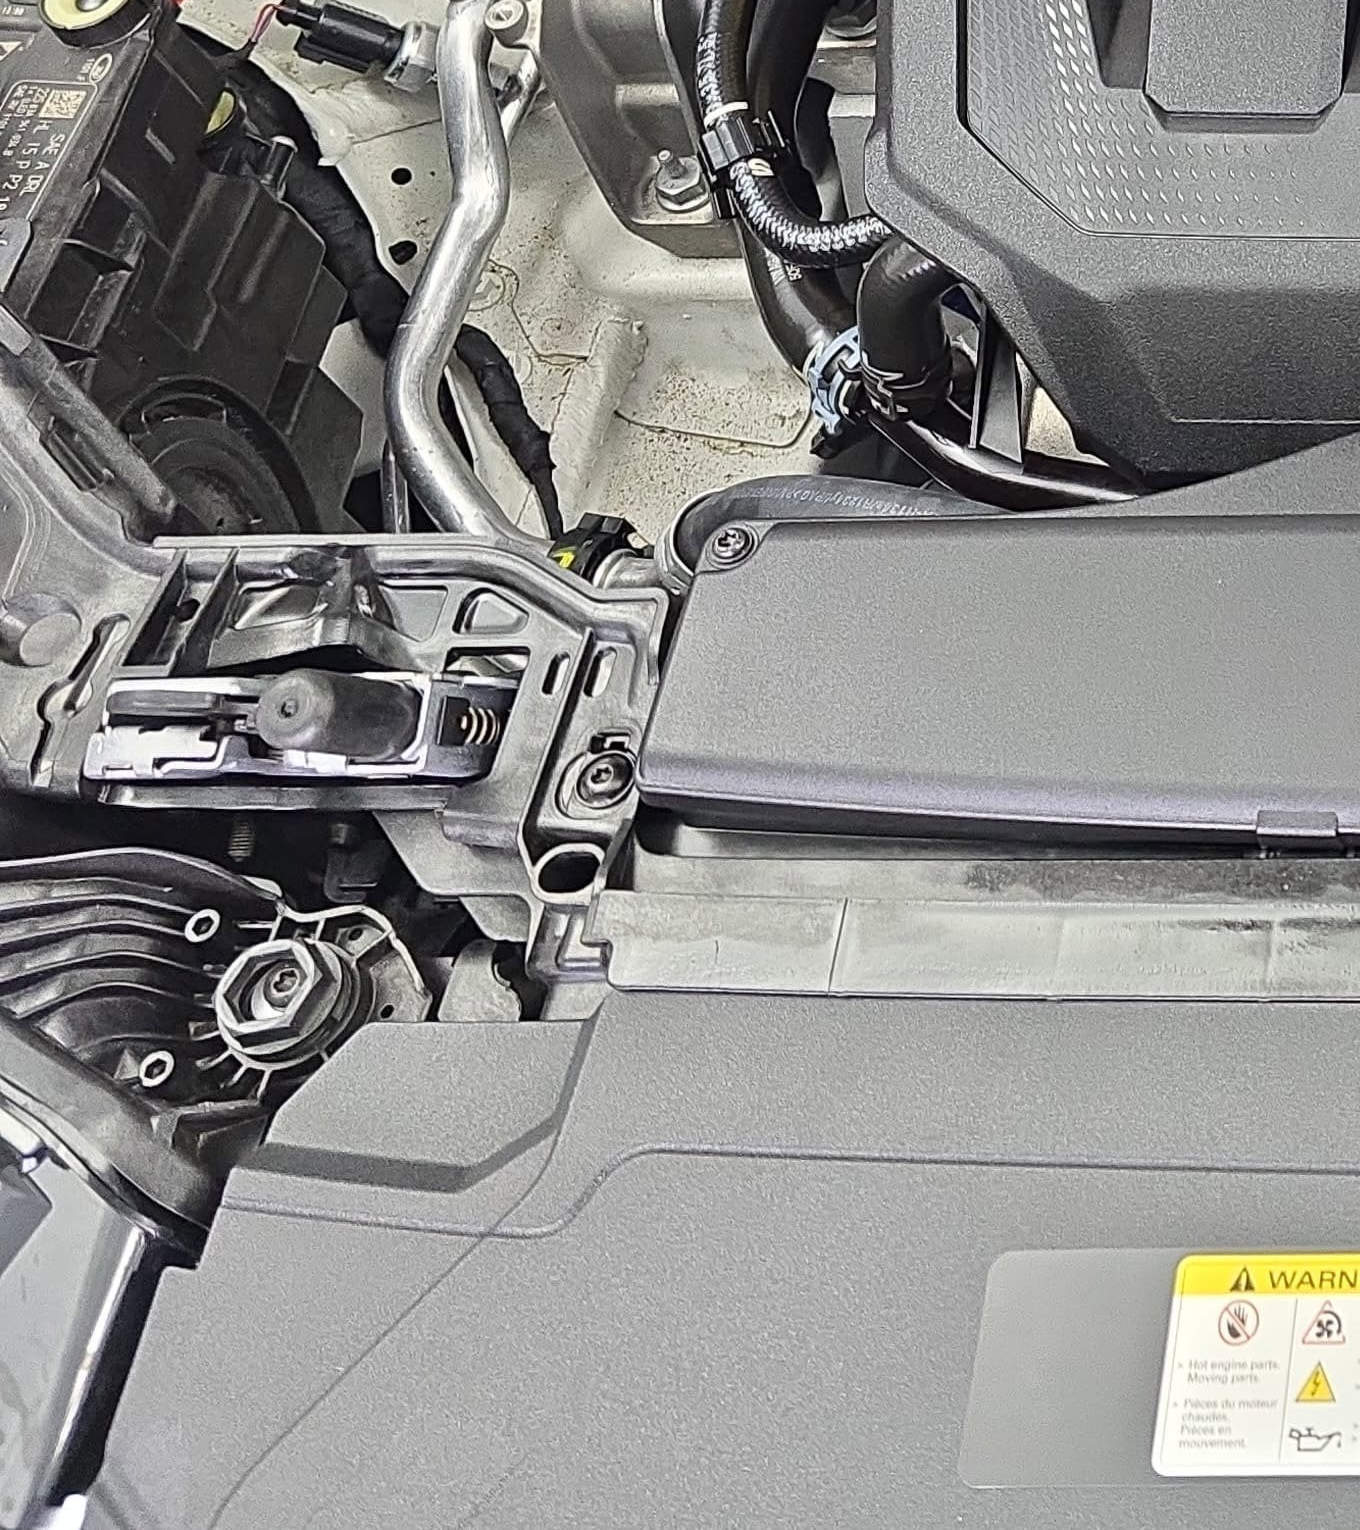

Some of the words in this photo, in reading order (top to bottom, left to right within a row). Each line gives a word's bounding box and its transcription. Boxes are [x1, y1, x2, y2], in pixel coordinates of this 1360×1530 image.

[22, 142, 41, 155] 15
[42, 133, 66, 156] SAE
[15, 160, 31, 170] P
[33, 161, 50, 171] A
[2, 173, 23, 191] P2
[18, 174, 44, 197] DRL
[1188, 1359, 1208, 1370] Hot
[1210, 1360, 1248, 1372] engine
[1187, 1373, 1229, 1385] Moving
